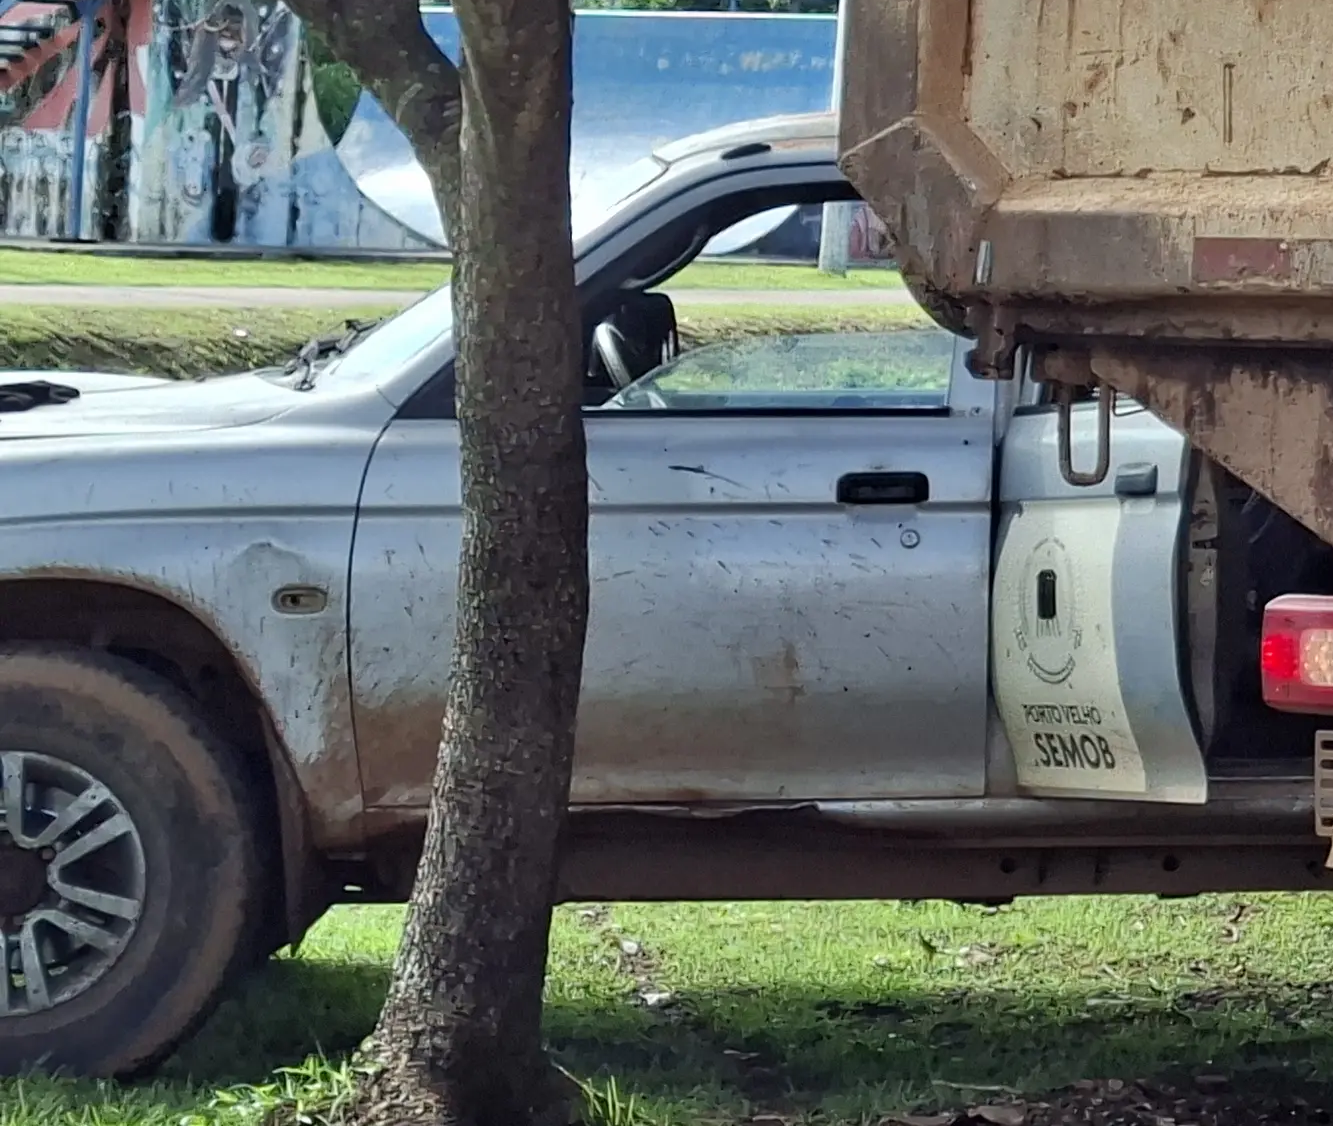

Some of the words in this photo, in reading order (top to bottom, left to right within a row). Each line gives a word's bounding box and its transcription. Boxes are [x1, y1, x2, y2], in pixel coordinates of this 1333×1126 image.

[1022, 704, 1061, 725] PORTO
[1062, 705, 1102, 726] VELHO
[1035, 733, 1116, 769] SEMOB
